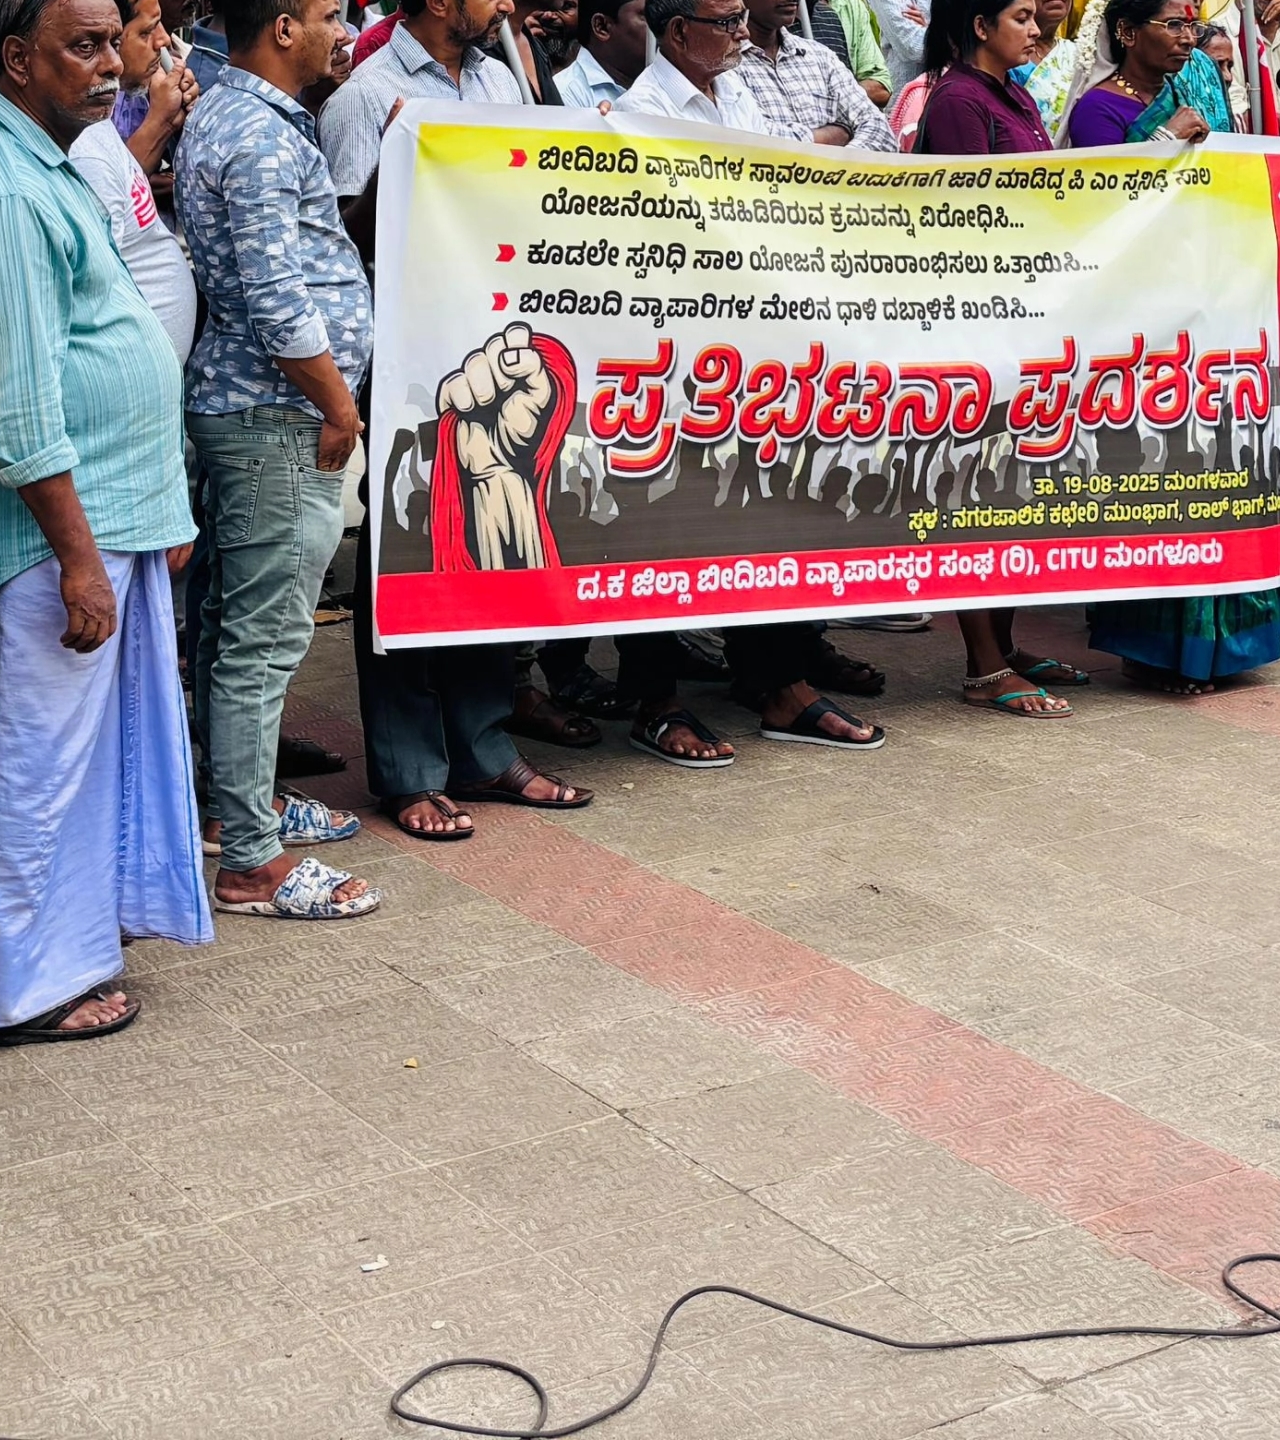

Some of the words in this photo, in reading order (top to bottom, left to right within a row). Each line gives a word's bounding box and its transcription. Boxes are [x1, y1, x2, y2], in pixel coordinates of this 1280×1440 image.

[537, 145, 639, 175] ಬೀದಿಬದಿ
[645, 154, 745, 188] ವ್ಯಾಪಾರಿಗಳ
[948, 167, 993, 188] ಜಾರಿ
[995, 167, 1065, 200] ಮಾಡಿದ್ದ
[1068, 169, 1085, 190] ಪಿ
[1090, 172, 1119, 191] ಎಂ
[1173, 167, 1211, 185] ಸಾಲ
[541, 187, 706, 232] ಯೋಜನೆಯನ್ನು
[708, 195, 825, 226] ತಡೆಹಿಡಿದಿರುವ
[829, 202, 916, 238] ಕ್ರಮವನ್ನು
[920, 202, 1025, 234] ವಿರೋಧಿಸಿ...
[527, 238, 619, 267] ಕೂಡಲೇ
[625, 242, 687, 280] ಸ್ವನಿಧಿ
[692, 247, 742, 271] ಸಾಲ
[749, 244, 825, 273] ಯೋಜನೆ
[519, 288, 621, 317] ಬೀದಿಬದಿ
[629, 292, 753, 329] ವ್ಯಾಪಾರಿಗಳ
[759, 293, 832, 321] ಮೇಲಿನ
[836, 297, 877, 326] ಧಾಳಿ
[882, 295, 956, 331] ದಬ್ಬಾಳಿಕೆ
[961, 295, 1045, 321] ಖಂಡಿಸಿ...
[588, 337, 993, 475] ಪ್ರತಿಭಟನಾ
[1007, 327, 1272, 458] ಪ್ರದರ್ಶನ
[1034, 476, 1059, 496] ತಾ.
[1063, 472, 1160, 495] 19-08-2025
[1164, 467, 1249, 491] ಮಂಗಳವಾರ
[908, 508, 938, 542] ಸ್ಥಳ
[952, 501, 1045, 528] ನಗರಪಾಲಿಕೆ
[1049, 501, 1099, 528] ಕಛೇರಿ
[1103, 498, 1183, 525] ಮುಂಭಾಗ,
[1188, 496, 1229, 519] ಲಾಲ್
[576, 569, 626, 601] ದ.ಕ
[631, 568, 692, 604] ಜಿಲ್ಲಾ
[697, 557, 798, 594] ಬೀದಿಬದಿ
[806, 550, 932, 597] ವ್ಯಾಪಾರಸ್ಥರ
[938, 547, 994, 581] ಸಂಘ
[1047, 546, 1097, 571] CITU
[1104, 538, 1223, 568] ಮಂಗಳೂರು
